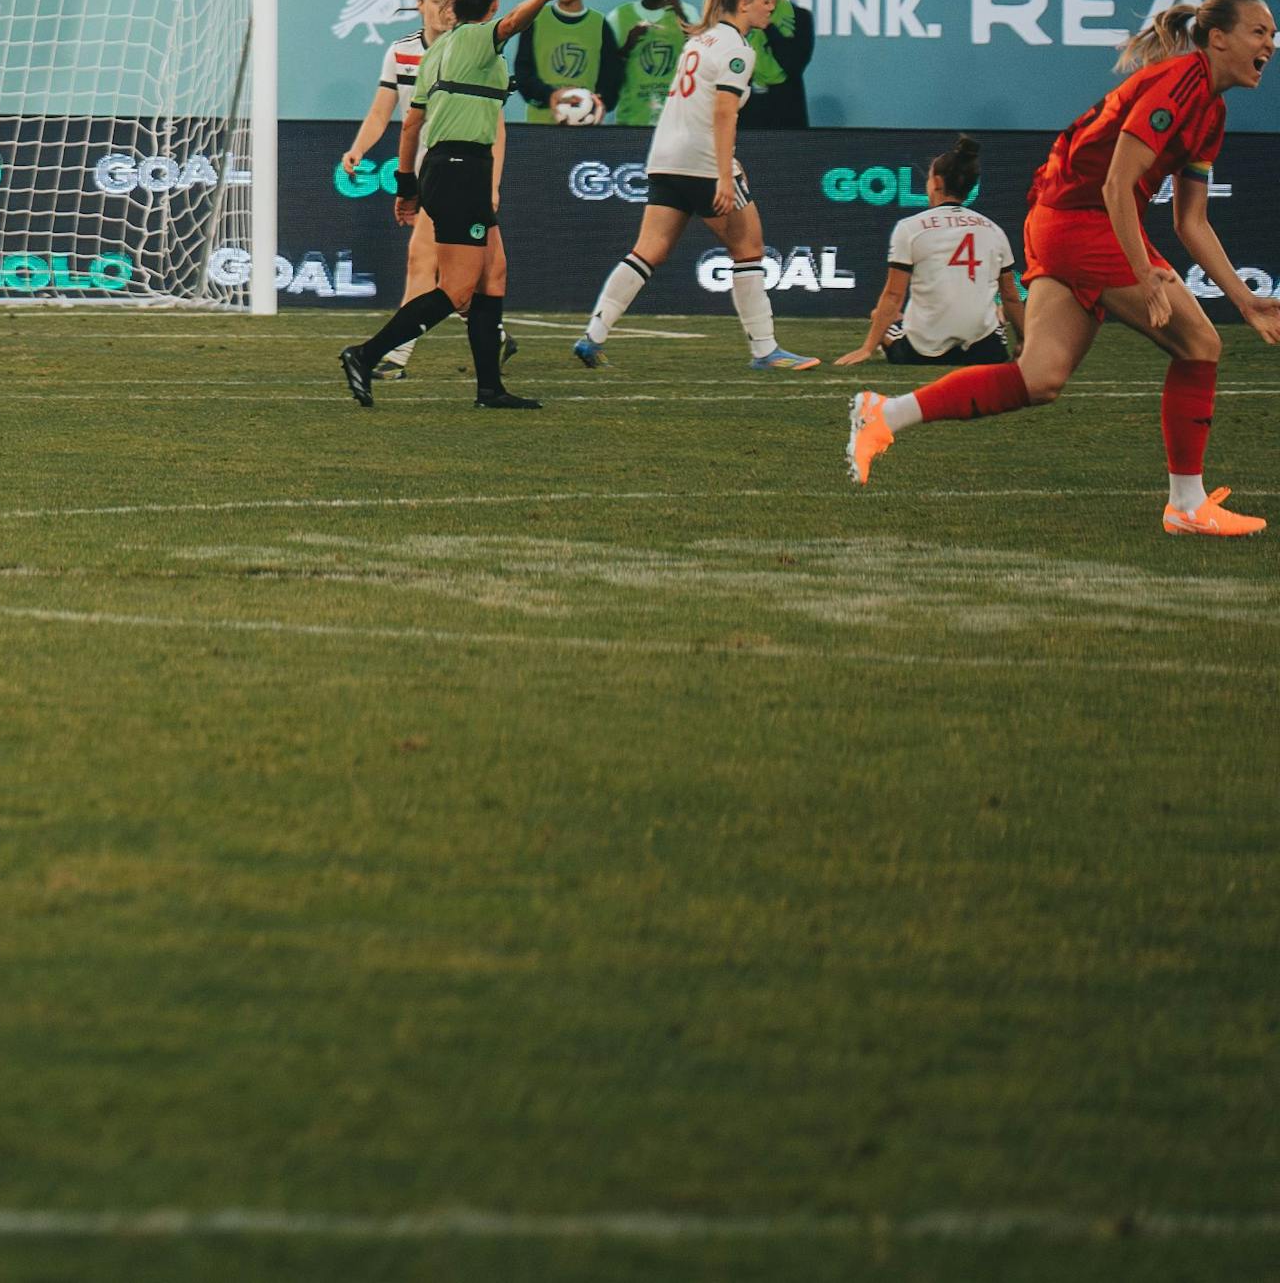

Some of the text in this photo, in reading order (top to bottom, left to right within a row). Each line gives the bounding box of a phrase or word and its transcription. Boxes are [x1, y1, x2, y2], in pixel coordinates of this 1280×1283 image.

[821, 165, 980, 207] GOL
[696, 246, 856, 292] GAL
[947, 232, 983, 284] 4
